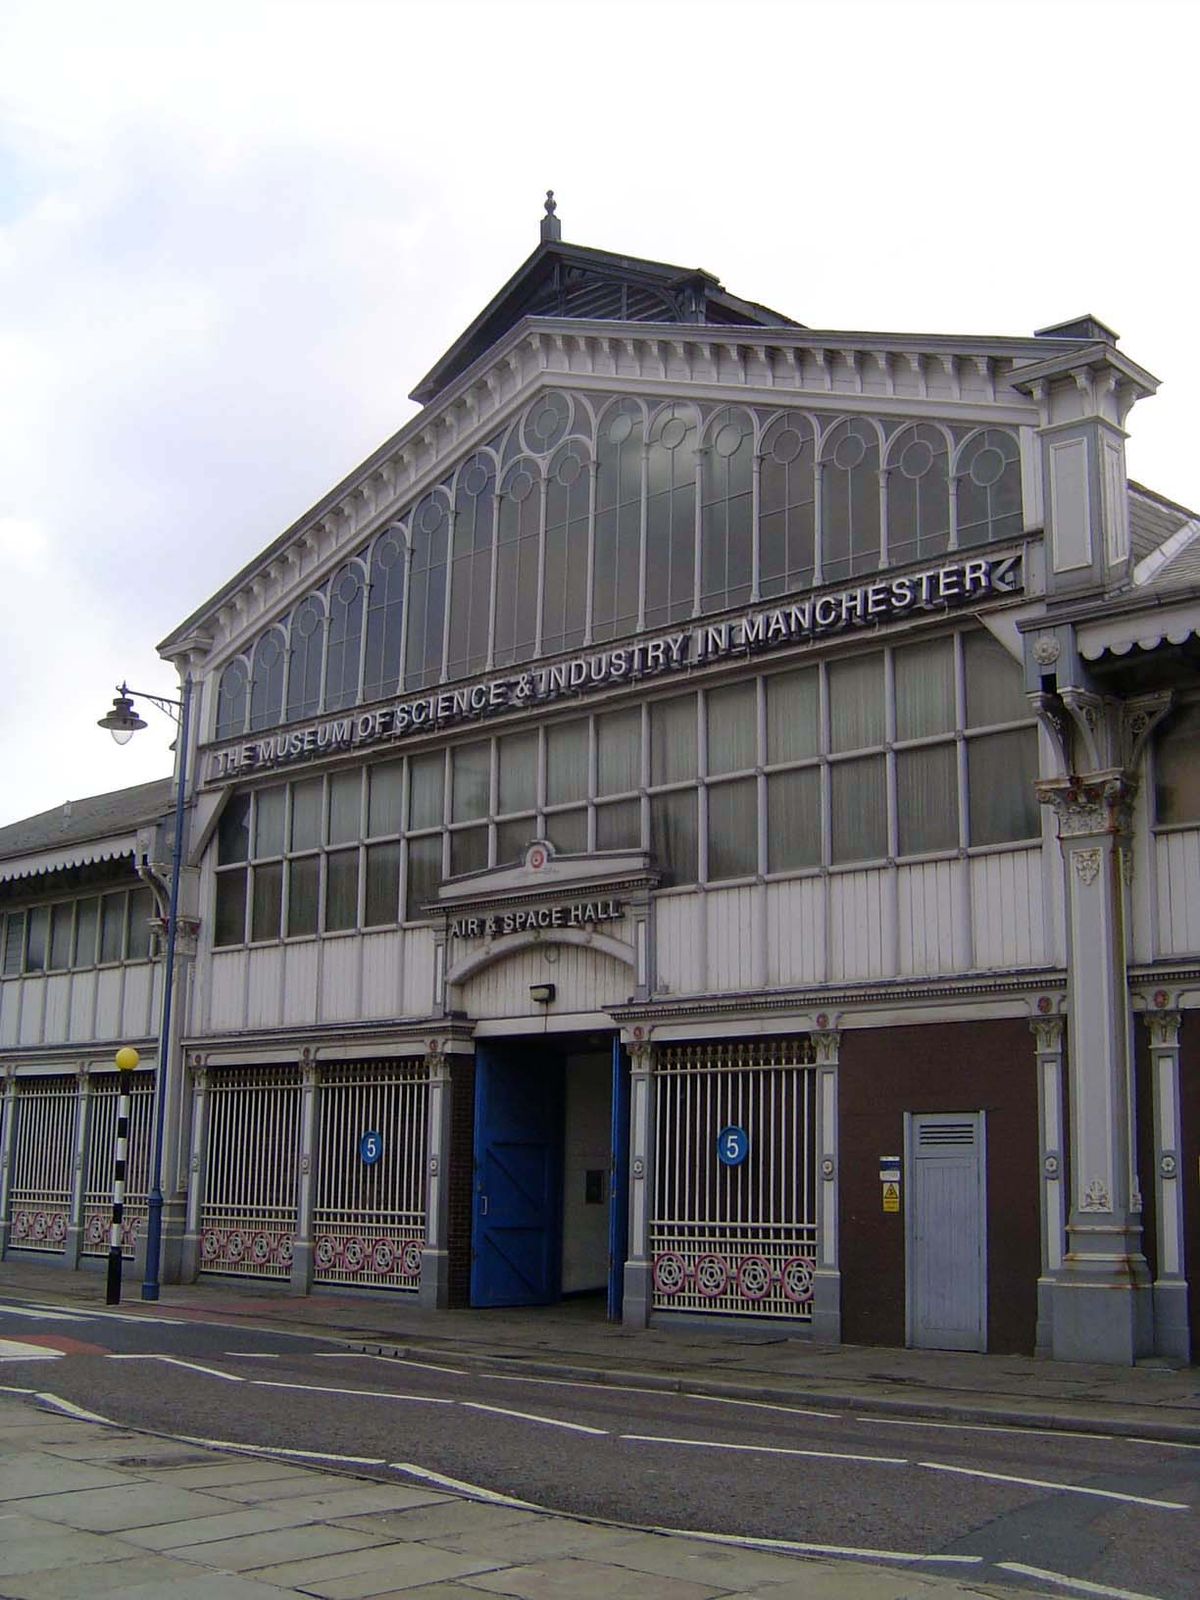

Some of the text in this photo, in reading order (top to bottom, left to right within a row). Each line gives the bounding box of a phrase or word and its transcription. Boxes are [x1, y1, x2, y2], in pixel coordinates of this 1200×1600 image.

[216, 559, 990, 772] THE MUSEUM OF SCIENCE & INDUSTRY IN MANCHESTER
[451, 901, 620, 936] AIR & SPACE HALL
[367, 1138, 376, 1157] 5
[726, 1135, 739, 1158] 5
